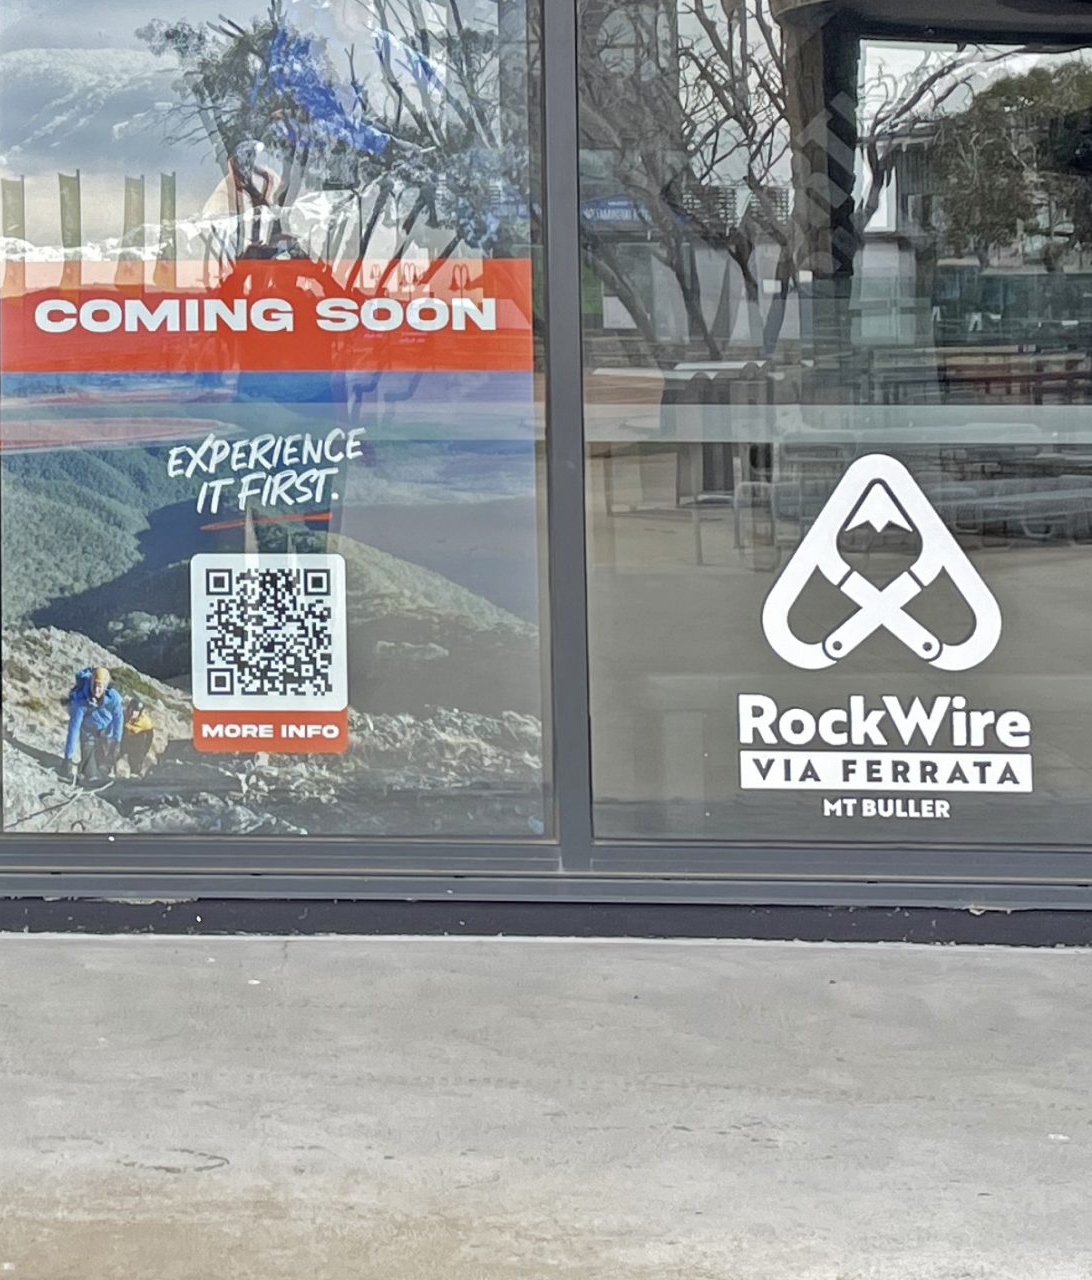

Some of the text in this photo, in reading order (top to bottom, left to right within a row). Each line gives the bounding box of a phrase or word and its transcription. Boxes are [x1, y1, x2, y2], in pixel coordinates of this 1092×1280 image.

[34, 298, 498, 333] COMING SOON
[167, 427, 366, 478] EXPERIENCE
[196, 467, 339, 514] IT FIRST.
[201, 723, 339, 739] MORE INFO
[738, 693, 1031, 748] RockWire
[753, 758, 1021, 784] VIA FERRATA
[823, 798, 950, 818] MT BULLER
